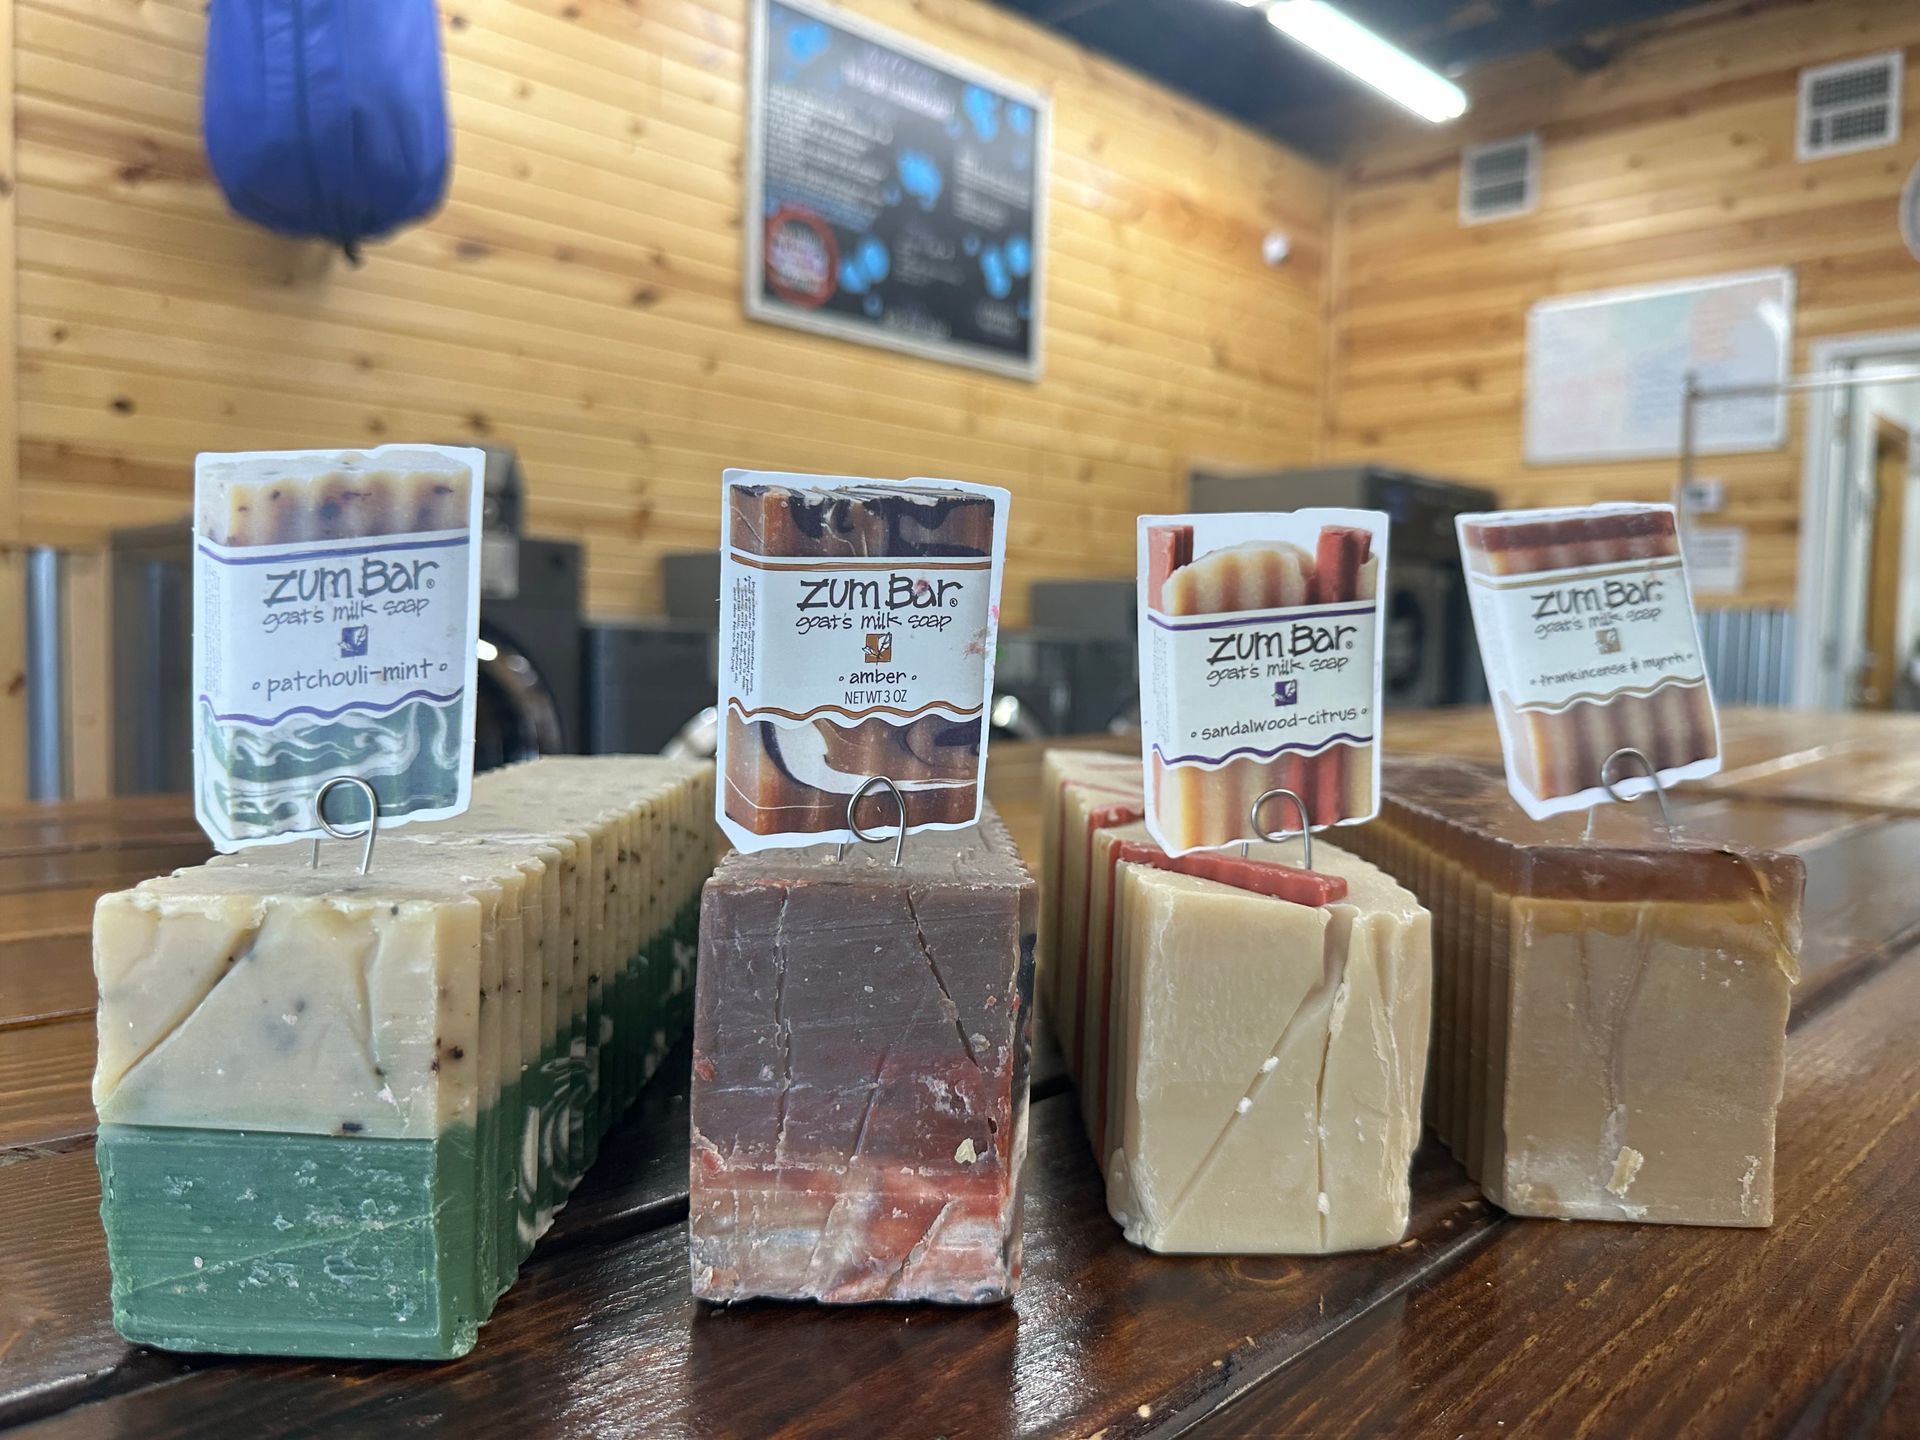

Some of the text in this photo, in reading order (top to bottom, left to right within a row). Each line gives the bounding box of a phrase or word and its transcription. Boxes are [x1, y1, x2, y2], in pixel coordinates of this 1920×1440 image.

[262, 598, 430, 633] goat's milk soap
[796, 611, 952, 634] goat's milk soap
[1588, 611, 1623, 628] milk
[267, 658, 432, 701] patchouli-mint
[850, 669, 906, 684] amber
[1206, 657, 1349, 687] goat's milk soap
[845, 690, 907, 704] NET WT 3 OZ
[1201, 707, 1357, 740] sandalwood-citrus
